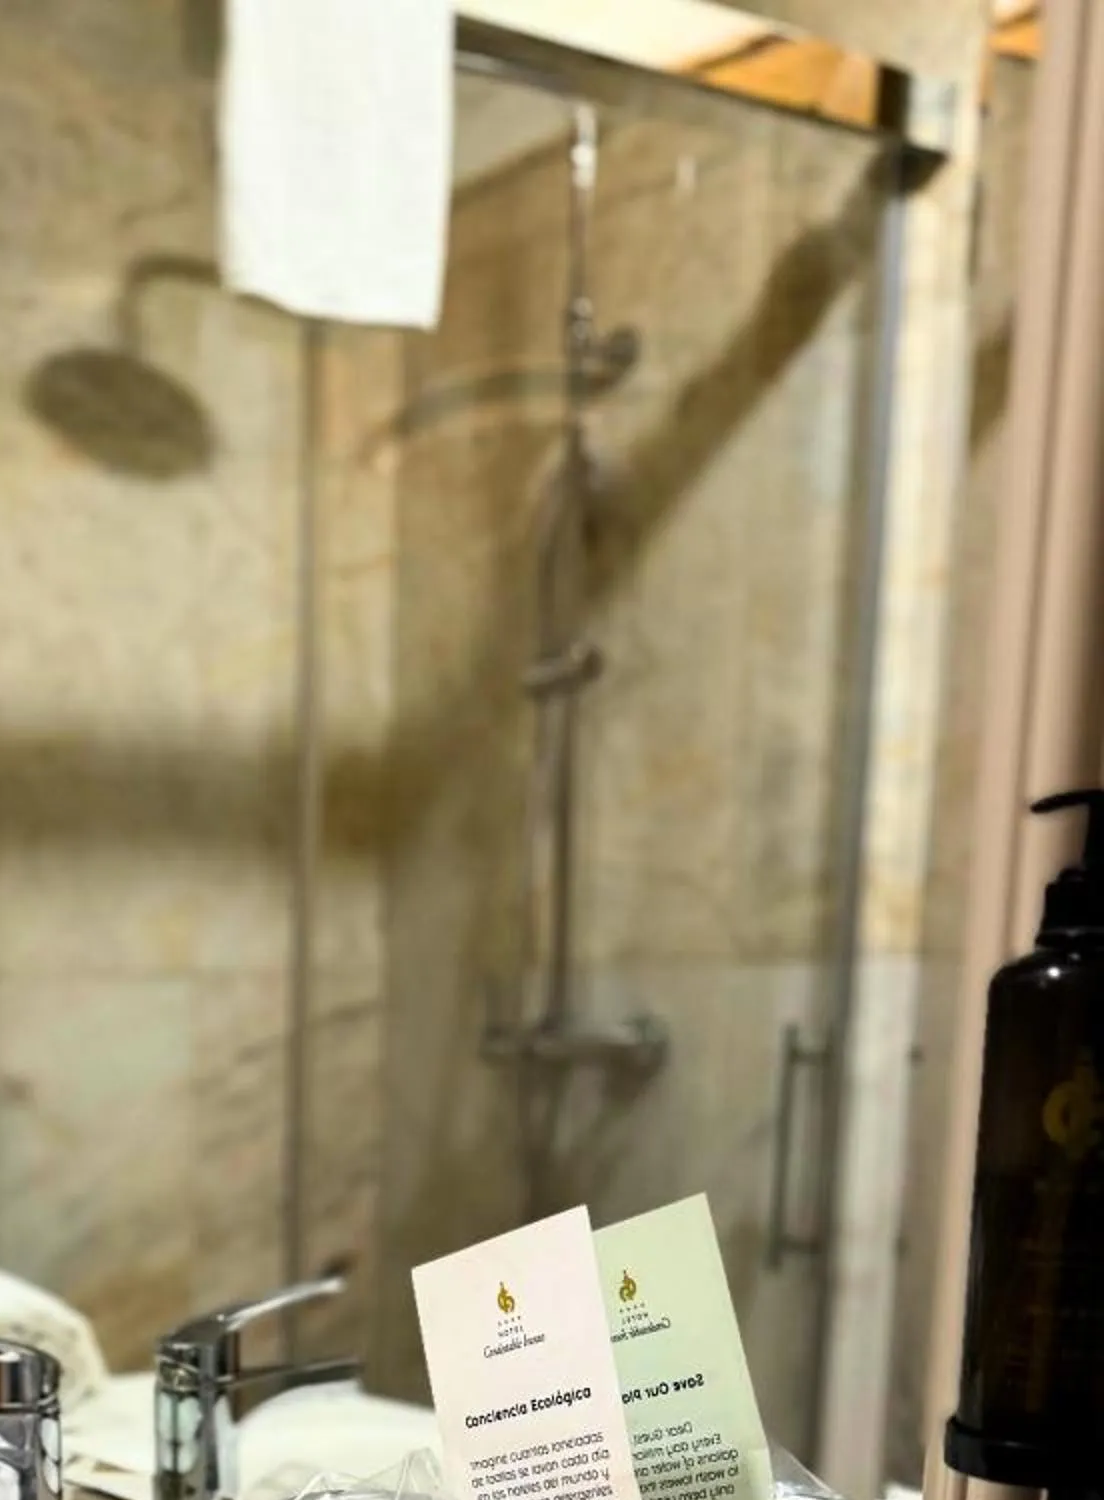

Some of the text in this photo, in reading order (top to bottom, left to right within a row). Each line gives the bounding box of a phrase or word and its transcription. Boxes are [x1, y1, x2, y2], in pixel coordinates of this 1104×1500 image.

[464, 1386, 593, 1429] Conciencia Ecológica
[560, 1452, 589, 1469] cada
[561, 1468, 599, 1487] mundo
